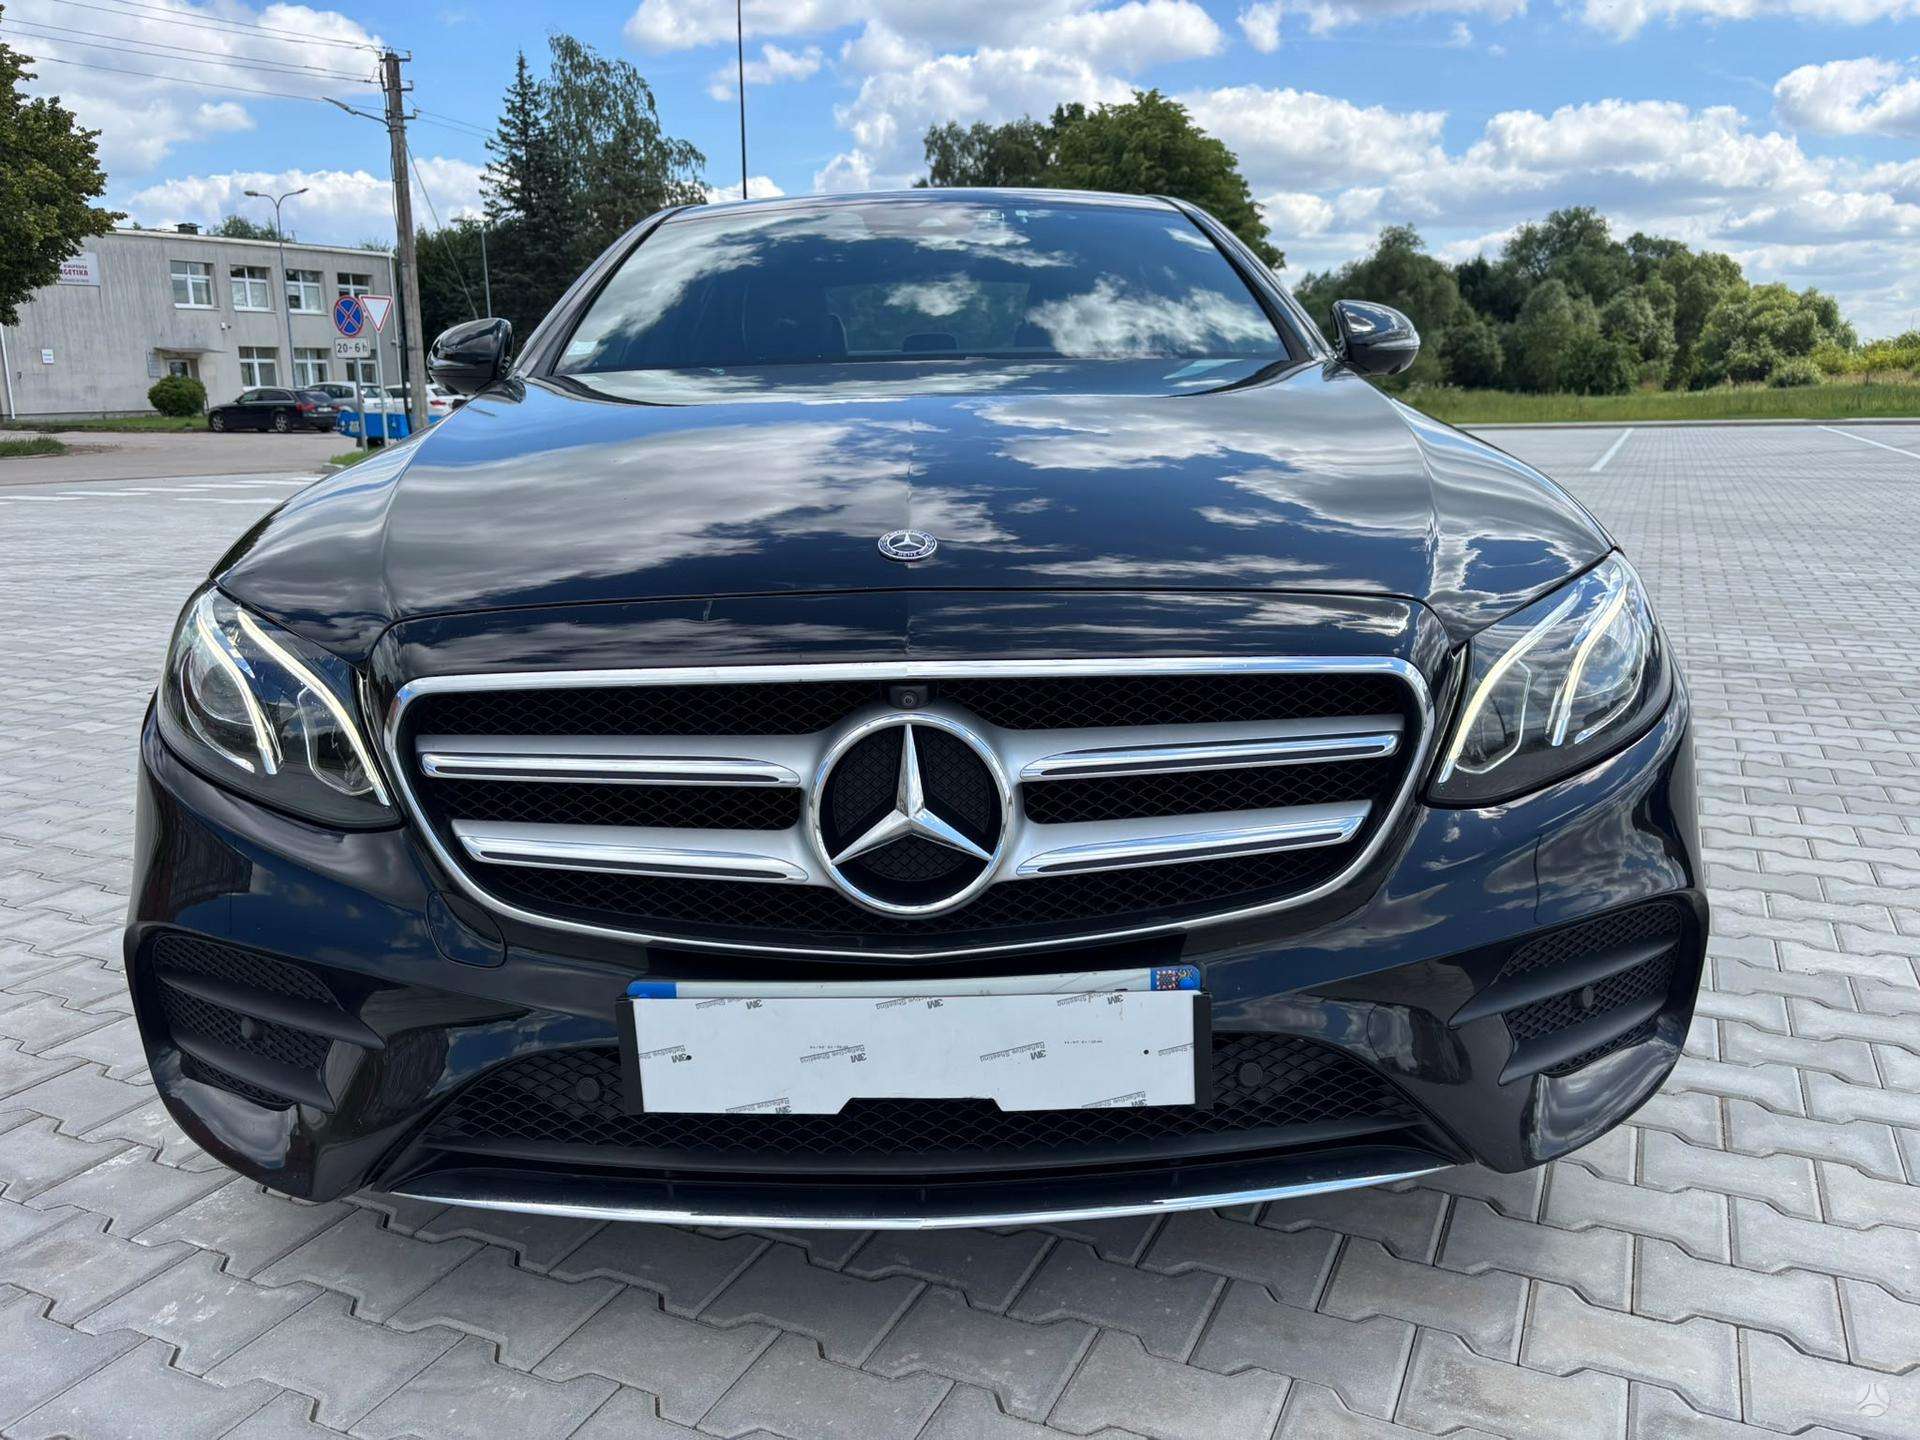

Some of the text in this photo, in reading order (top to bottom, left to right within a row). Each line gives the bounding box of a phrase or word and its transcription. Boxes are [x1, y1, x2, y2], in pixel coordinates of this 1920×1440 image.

[746, 999, 763, 1010] 3M
[927, 999, 944, 1010] 3M
[1107, 994, 1124, 1005] 3M
[671, 1053, 687, 1064] 3M
[850, 1052, 867, 1063] 3M
[1030, 1050, 1047, 1061] 3M
